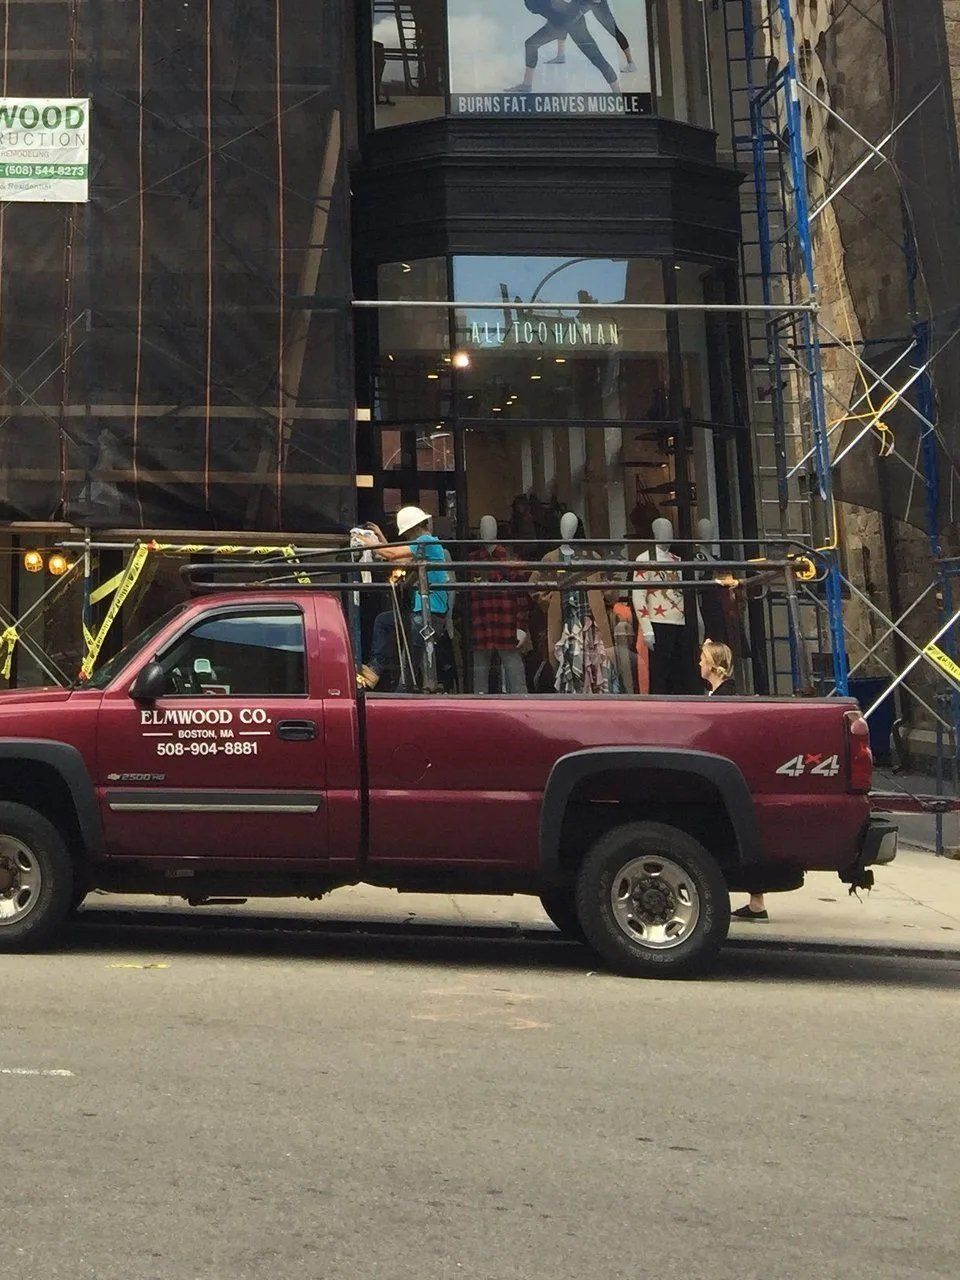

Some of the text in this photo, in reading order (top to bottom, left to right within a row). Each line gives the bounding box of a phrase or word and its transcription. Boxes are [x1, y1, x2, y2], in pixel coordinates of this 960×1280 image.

[458, 96, 644, 113] BURNS FAT. CARVES MUSCLE.
[5, 166, 33, 176] (508)
[34, 166, 84, 176] 544-8273
[472, 322, 619, 345] ALL TOO HUMAN
[141, 709, 272, 725] ELMWOOD CO.
[178, 730, 234, 739] BOSTON, MA
[157, 742, 258, 755] 508-904-8881
